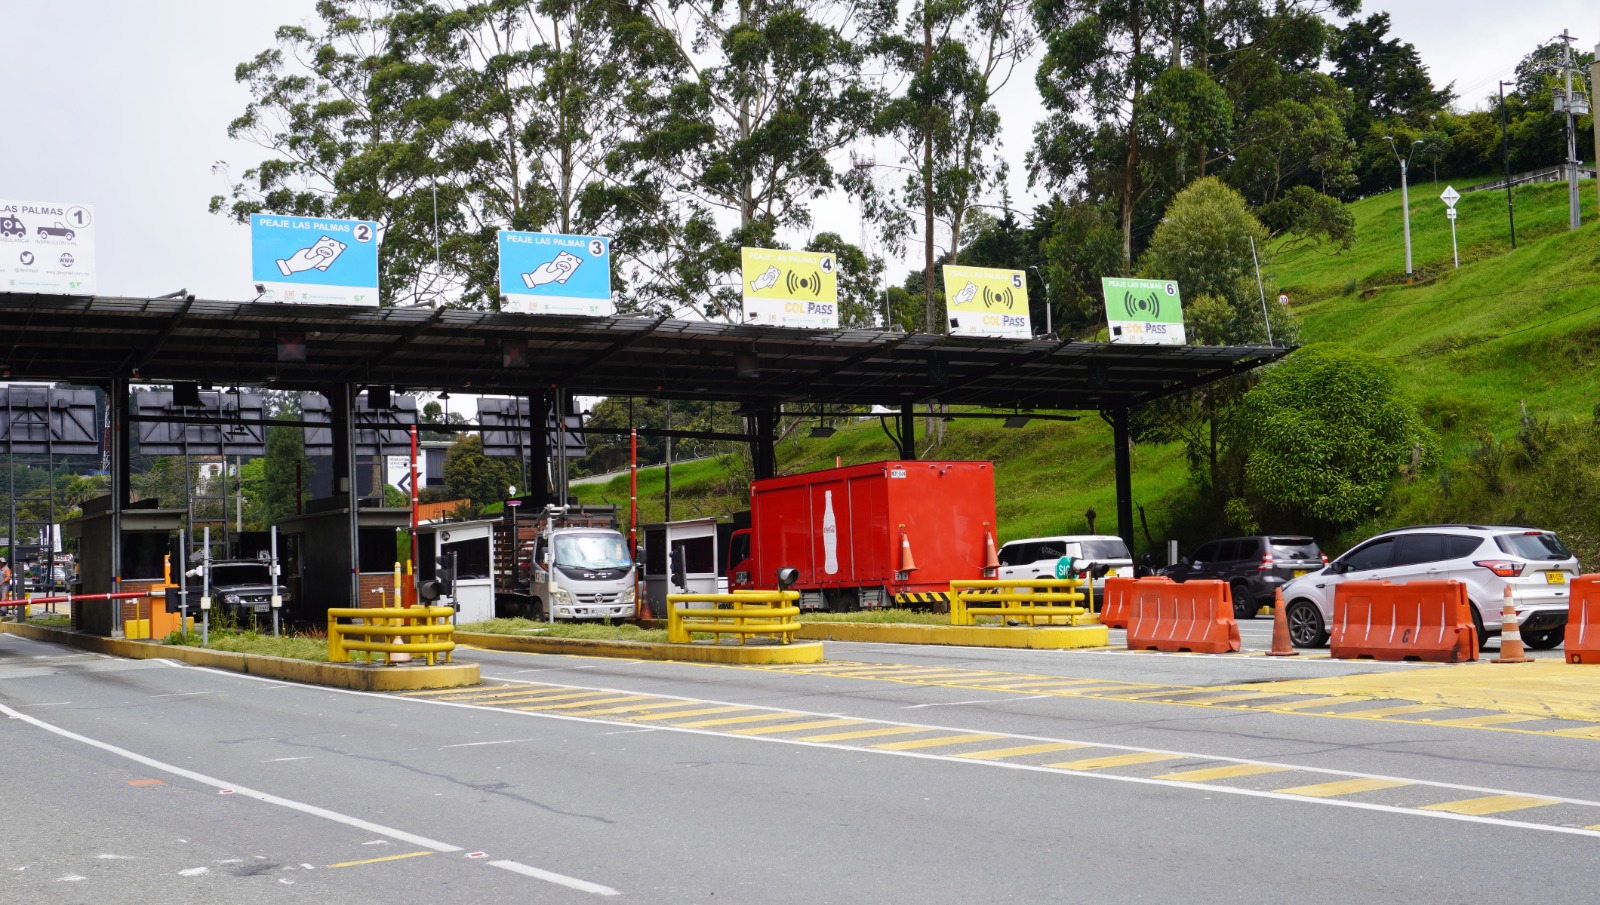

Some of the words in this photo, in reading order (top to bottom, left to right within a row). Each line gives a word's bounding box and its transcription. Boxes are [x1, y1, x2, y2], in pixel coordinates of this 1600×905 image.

[22, 206, 64, 216] PALMAS
[73, 209, 83, 225] 1
[260, 218, 290, 228] PEAJE
[292, 220, 311, 230] LAS
[313, 222, 350, 232] PALMAS
[357, 225, 369, 240] 2
[506, 234, 532, 244] PEAJE
[535, 237, 551, 245] LAS
[553, 238, 586, 248] PALMAS
[592, 240, 602, 255] 3
[748, 252, 771, 260] PEAJE
[773, 254, 787, 262] LAS
[789, 255, 817, 264] PALMAS
[822, 258, 832, 271] 4
[1013, 274, 1022, 288] 5
[1108, 280, 1127, 288] PEAJE
[1166, 283, 1174, 295] 6
